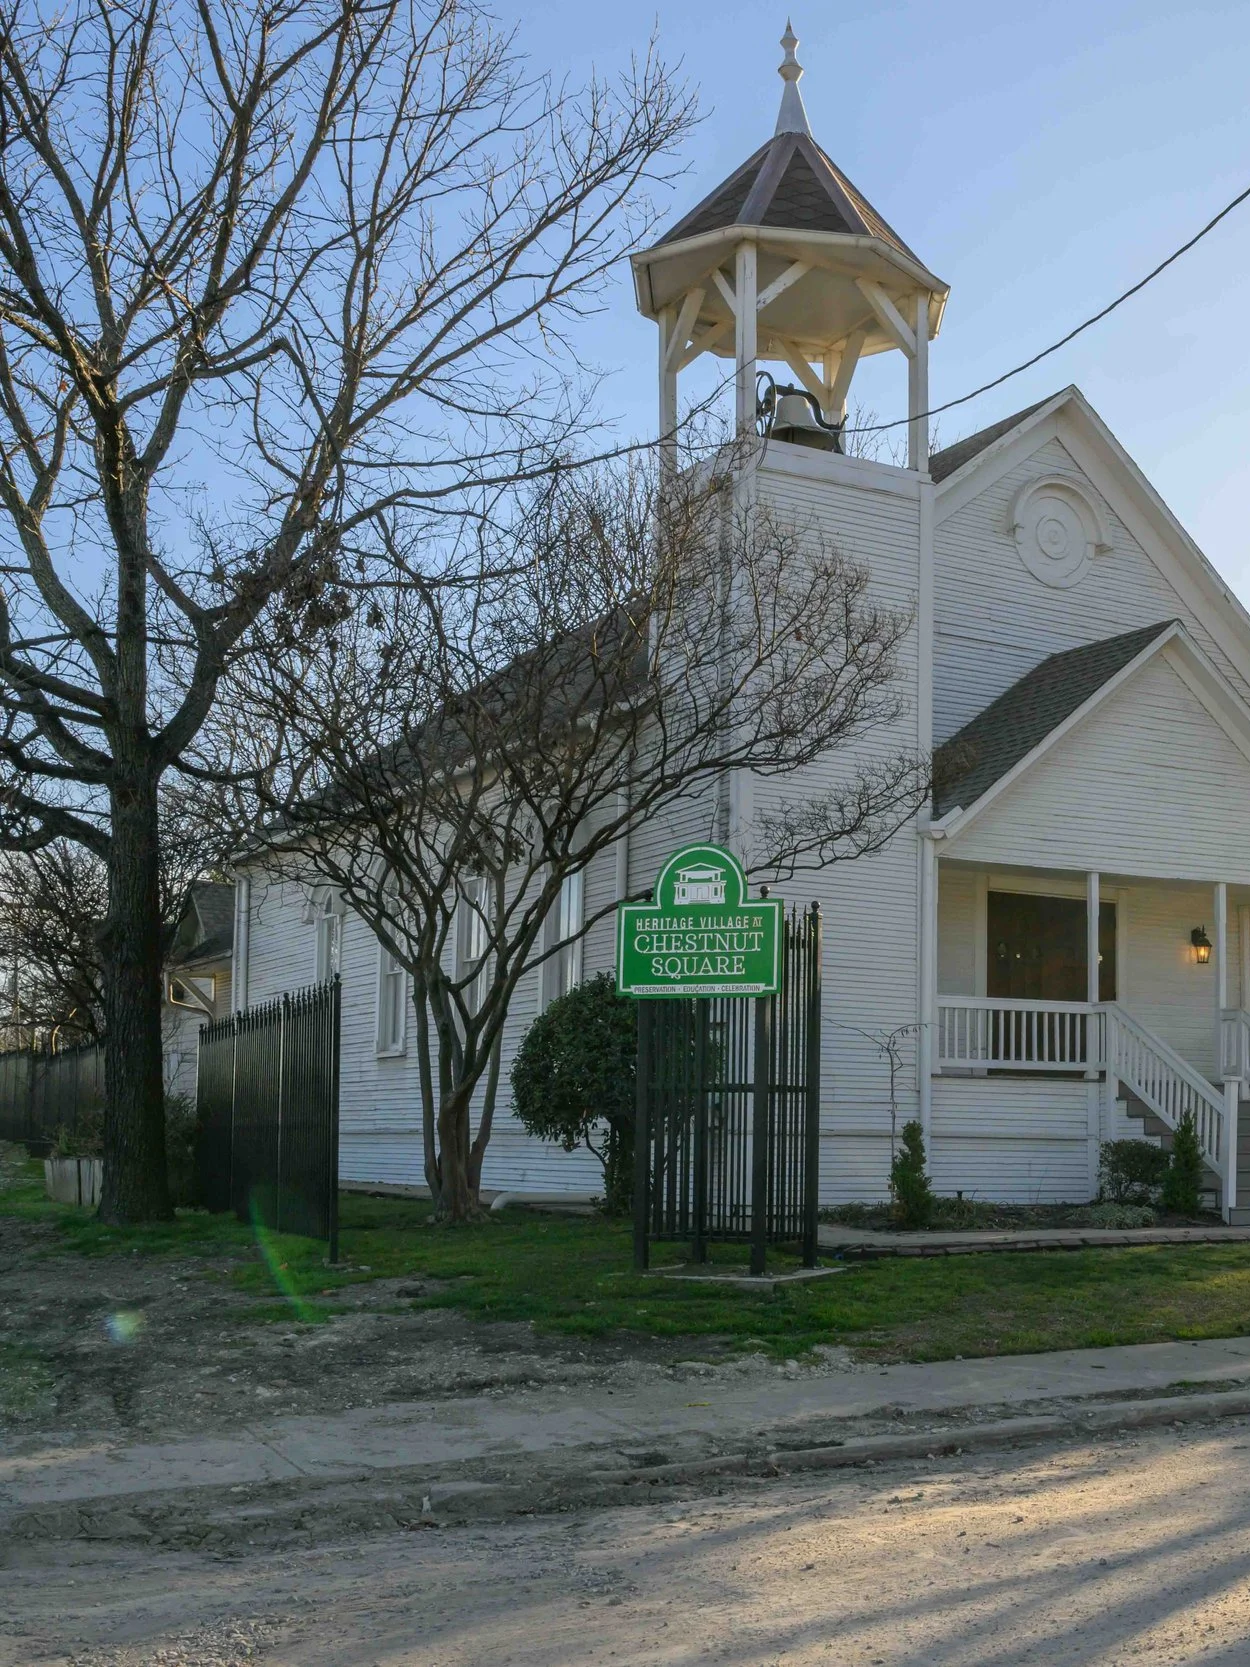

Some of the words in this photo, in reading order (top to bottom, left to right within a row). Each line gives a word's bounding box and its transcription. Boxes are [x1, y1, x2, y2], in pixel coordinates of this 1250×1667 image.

[636, 917, 694, 931] HERITAGE
[700, 916, 749, 929] VILLAGE
[752, 917, 763, 928] AT
[634, 932, 764, 953] CHESTNUT
[651, 955, 746, 980] SQUARE
[634, 985, 676, 993] PRESERVATION
[721, 984, 761, 992] CELEBRATION
